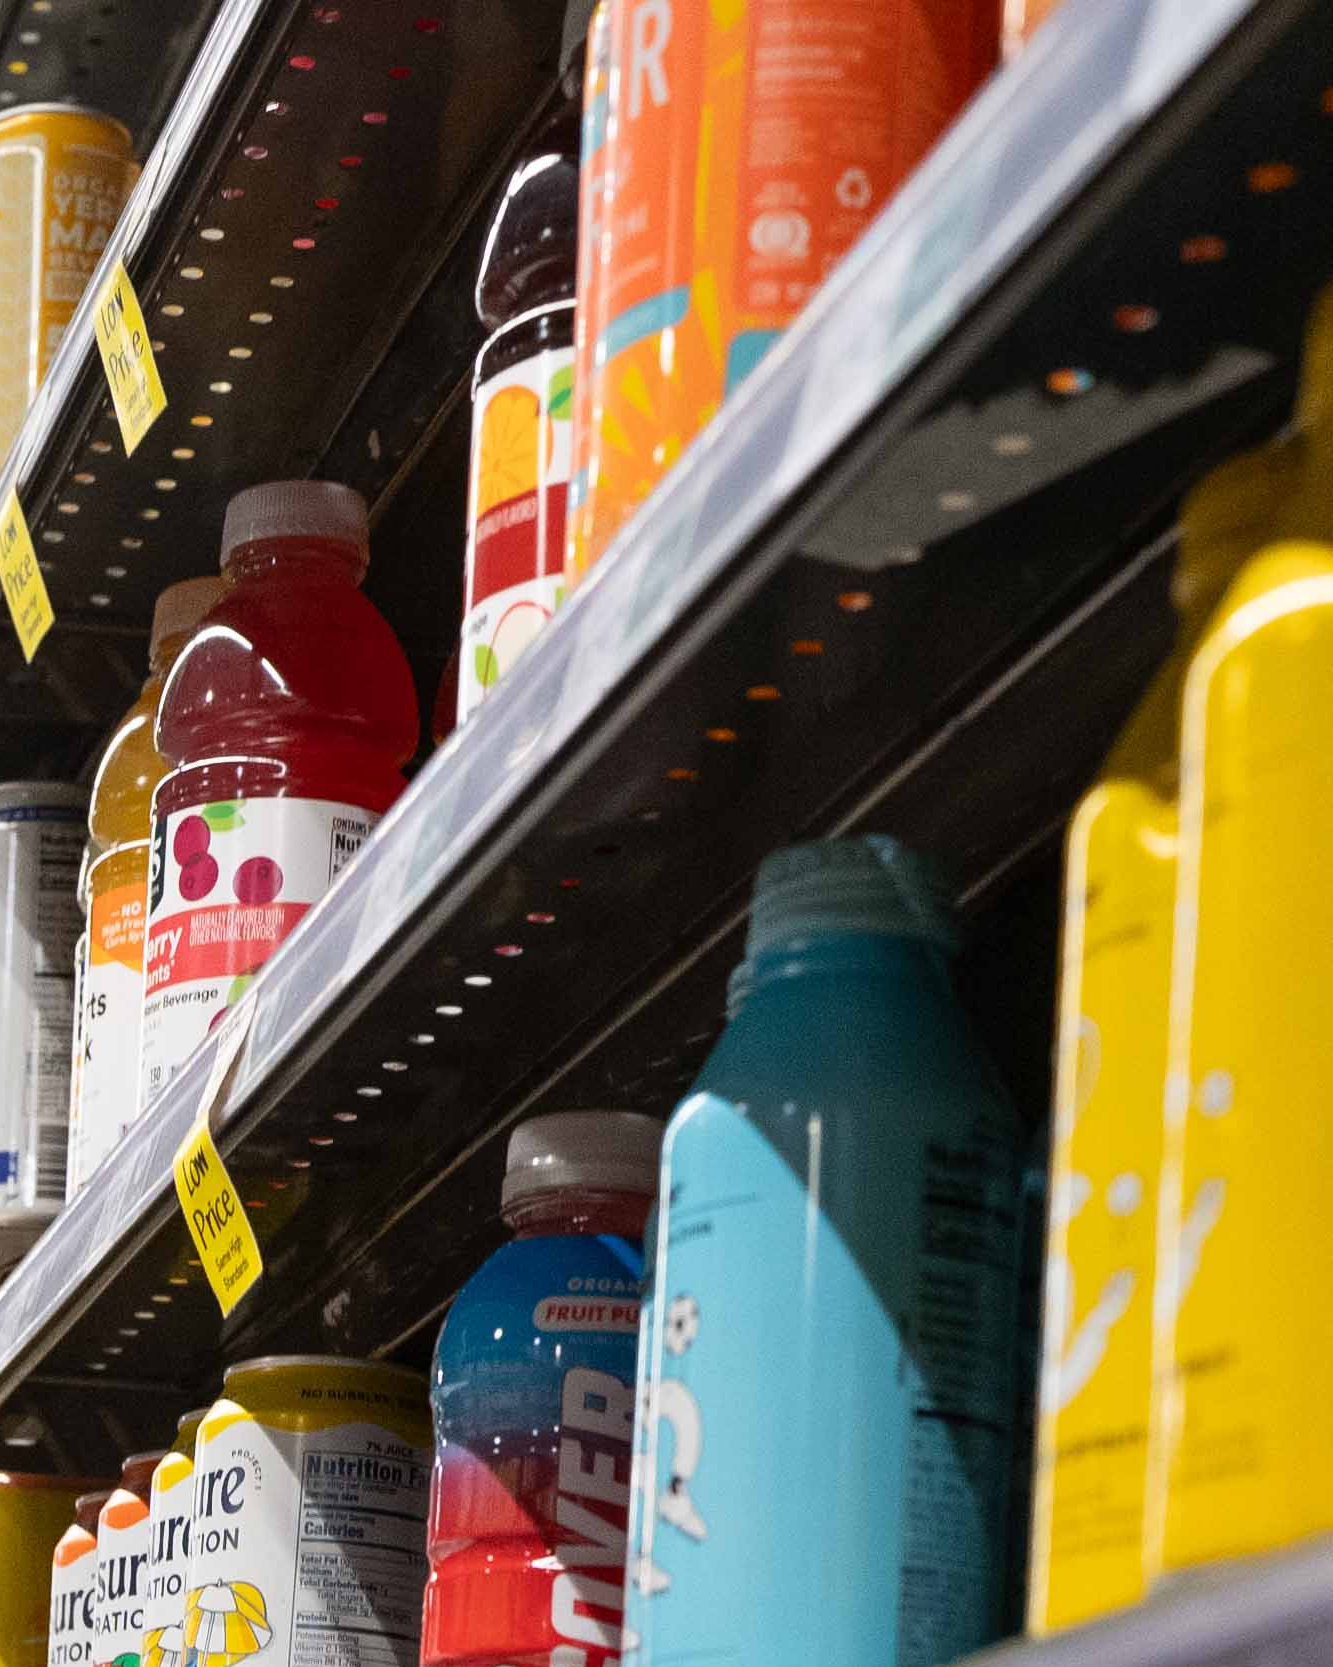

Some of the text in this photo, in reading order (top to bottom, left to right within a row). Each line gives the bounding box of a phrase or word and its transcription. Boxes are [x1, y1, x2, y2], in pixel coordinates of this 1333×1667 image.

[122, 902, 141, 917] NO
[228, 909, 264, 925] FLAVORED
[265, 908, 285, 923] WITH
[189, 924, 277, 946] OTHER NATURAL FLAVORS
[163, 987, 218, 1010] Beverage
[183, 1145, 208, 1196] Low
[193, 1189, 235, 1250] Price
[543, 1305, 605, 1322] FRUIT
[307, 1456, 402, 1485] Nutrition
[305, 1522, 364, 1538] Calories
[194, 1527, 239, 1556] ION
[297, 1613, 327, 1623] Protein
[295, 1642, 323, 1652] Vitamin
[294, 1654, 323, 1665] Vitamin
